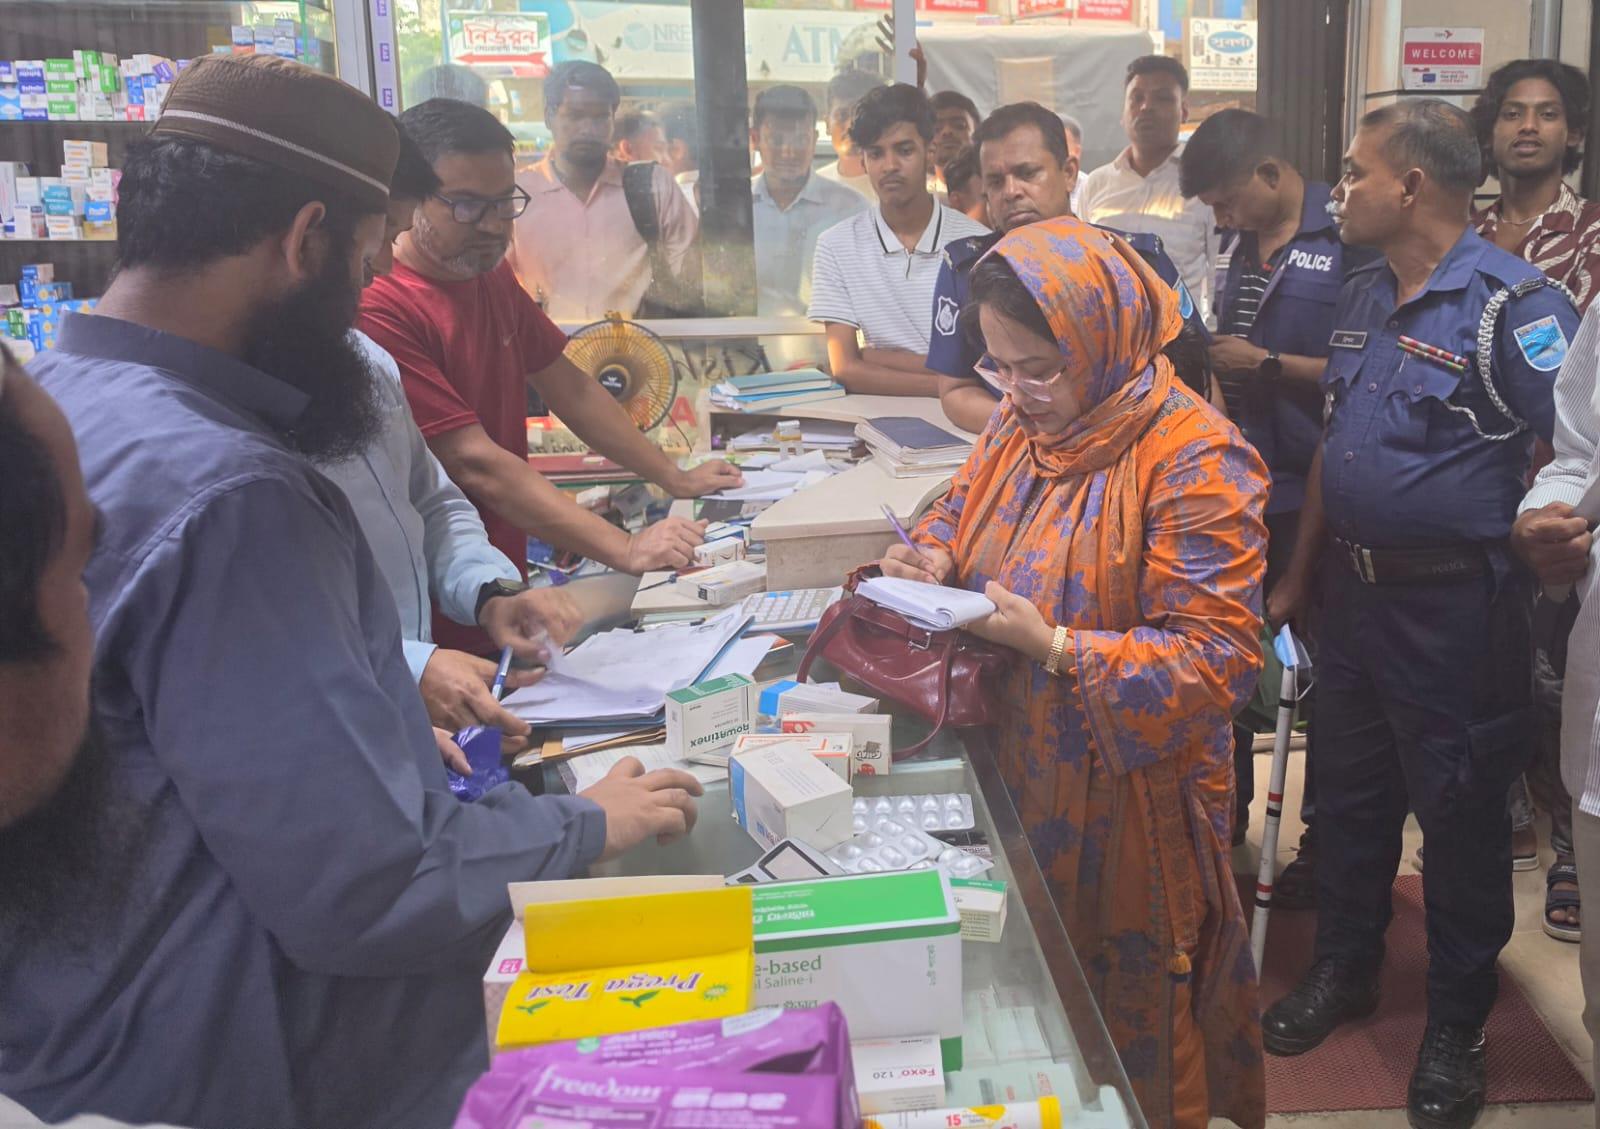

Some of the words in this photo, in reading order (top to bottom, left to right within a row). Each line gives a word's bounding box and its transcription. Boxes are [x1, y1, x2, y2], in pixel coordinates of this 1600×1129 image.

[1411, 48, 1475, 59] WELCOME
[1288, 249, 1333, 272] POLICE
[755, 954, 822, 977] e-based
[525, 980, 592, 1003] Test
[604, 971, 704, 995] Prega
[532, 1063, 663, 1103] freedom
[872, 1070, 894, 1081] 120
[901, 1067, 937, 1079] Fexo
[946, 1113, 962, 1127] 15
